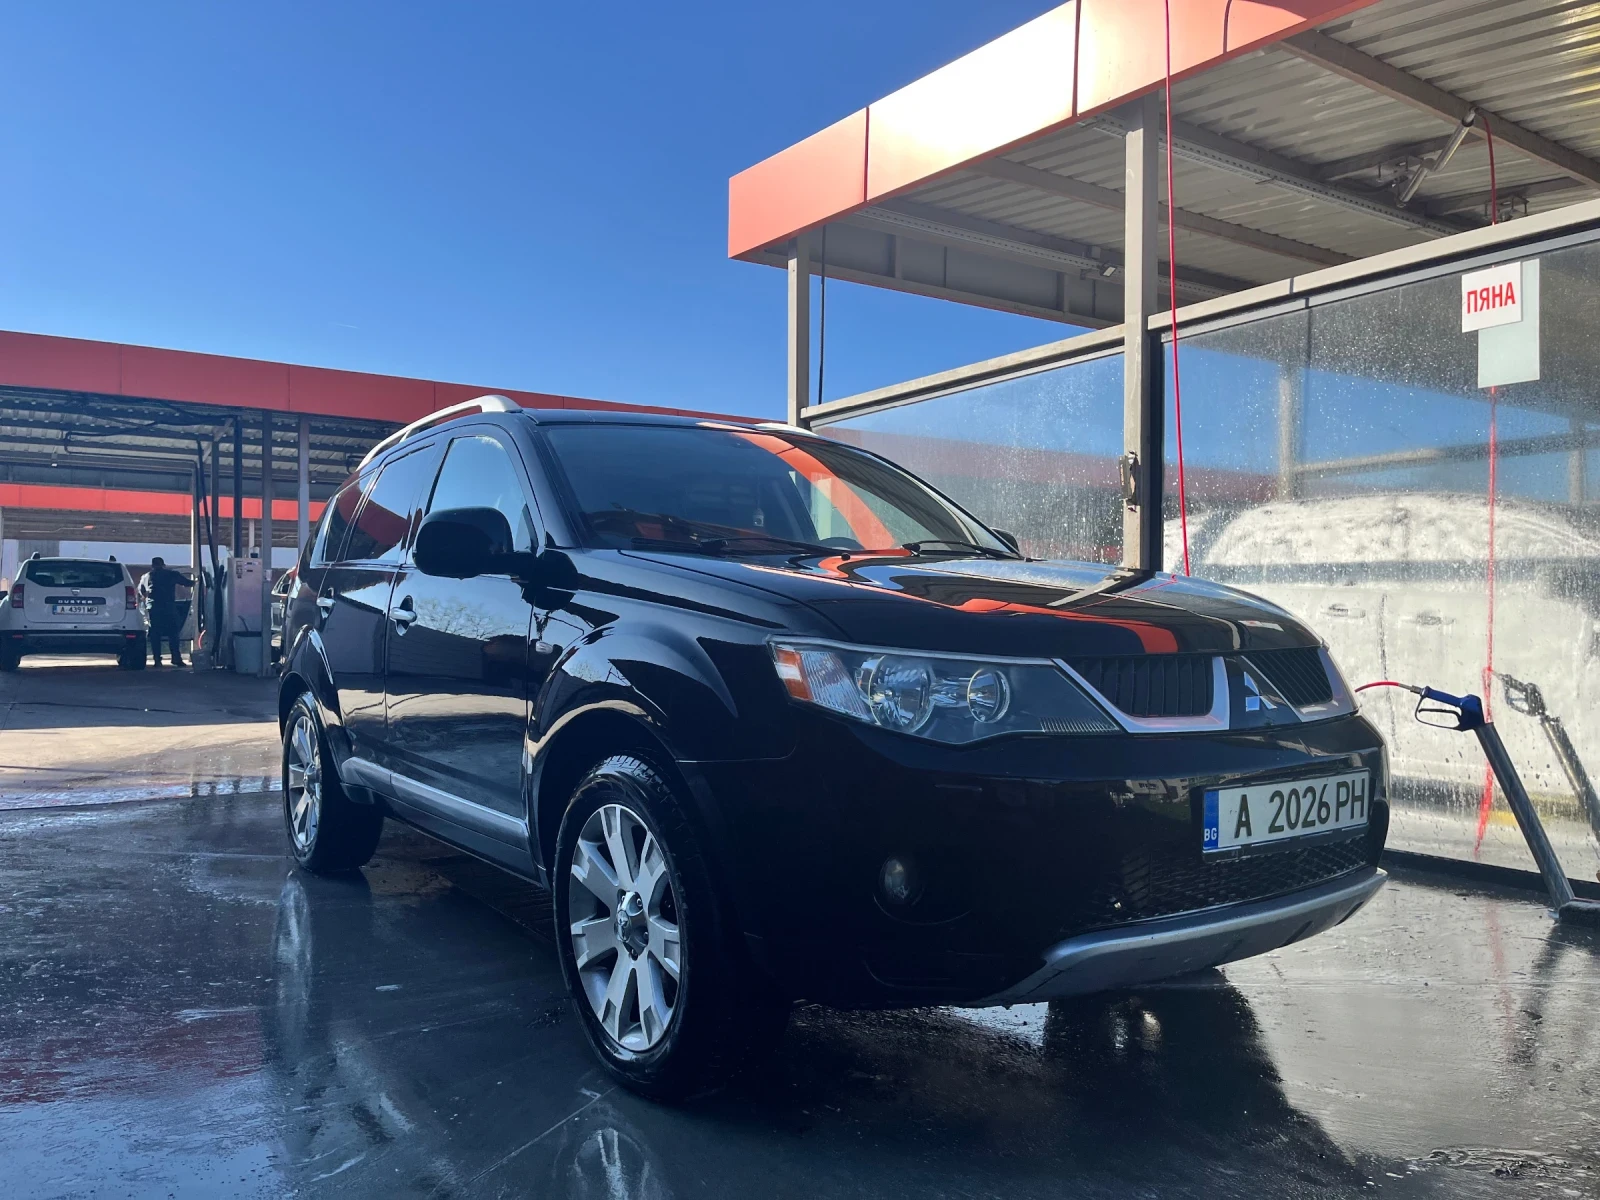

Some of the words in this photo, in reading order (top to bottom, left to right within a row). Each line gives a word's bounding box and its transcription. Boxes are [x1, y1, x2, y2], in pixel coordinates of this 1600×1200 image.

[1467, 282, 1516, 314] ПЯНА
[1234, 794, 1252, 838] A
[1268, 784, 1331, 834] 2026
[1335, 778, 1366, 822] PH
[1204, 828, 1218, 842] BG
